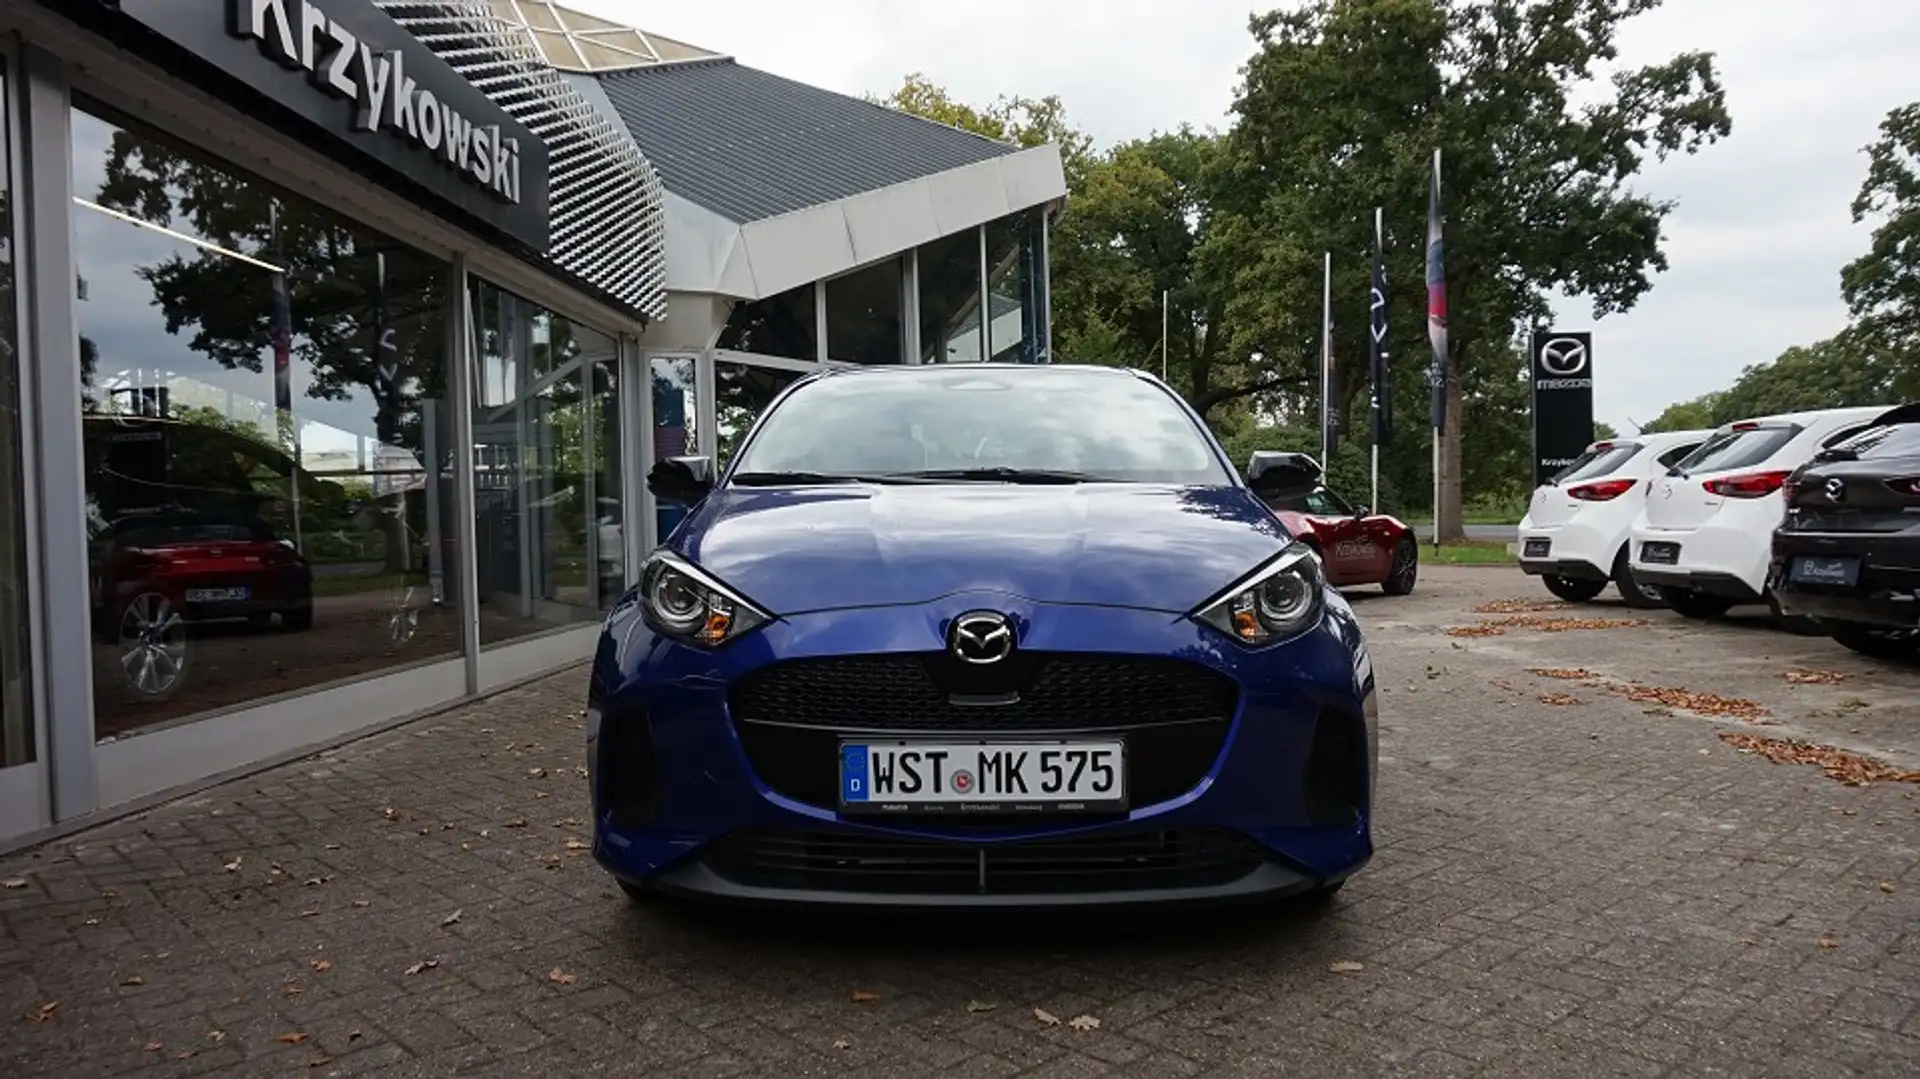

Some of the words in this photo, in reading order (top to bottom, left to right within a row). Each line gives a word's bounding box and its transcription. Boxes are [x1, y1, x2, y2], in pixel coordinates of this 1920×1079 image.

[850, 778, 861, 793] D
[872, 751, 949, 794] WST
[978, 751, 1028, 794] MK
[1040, 751, 1114, 793] 575
